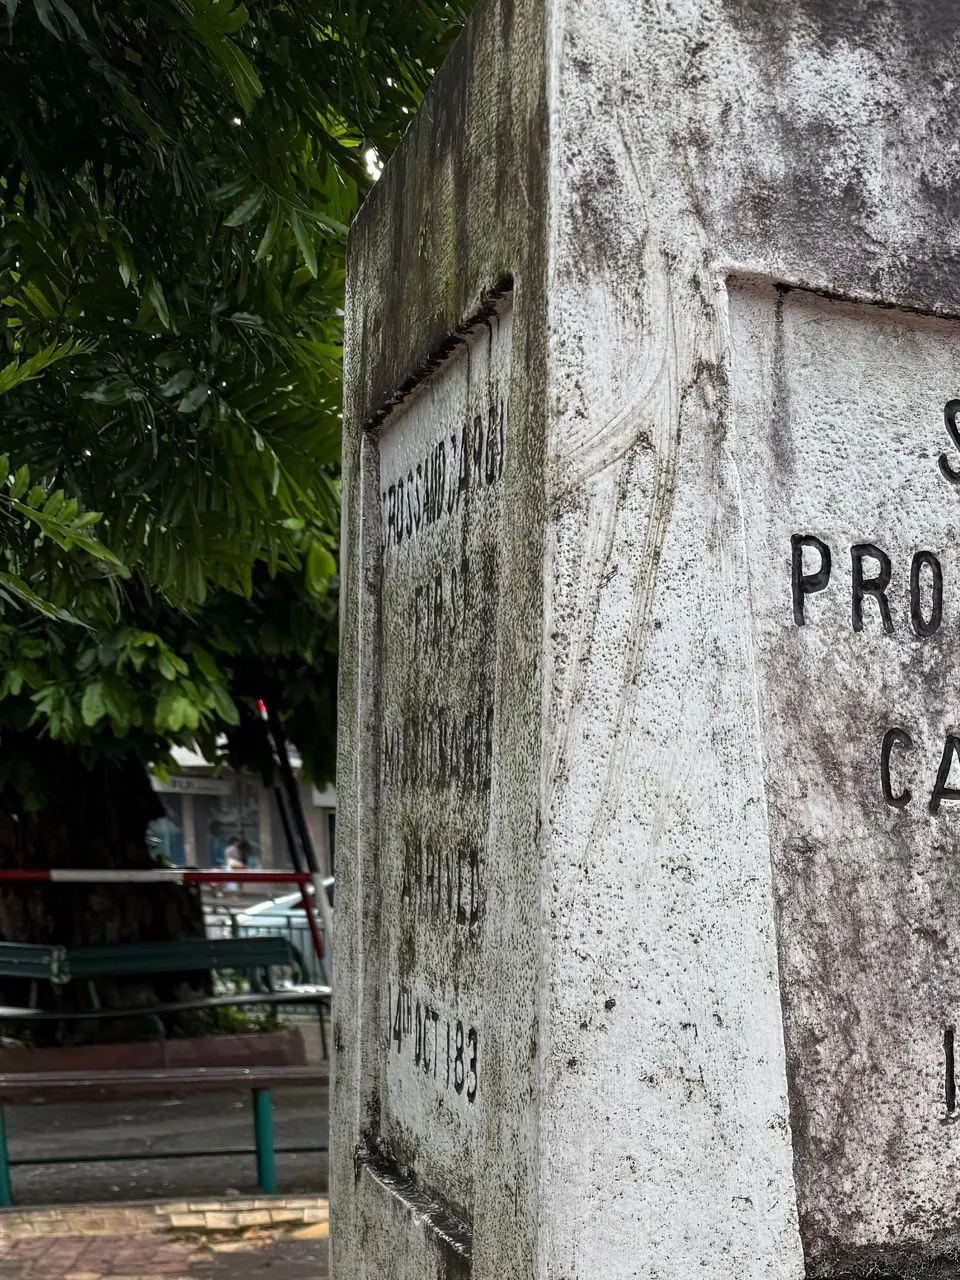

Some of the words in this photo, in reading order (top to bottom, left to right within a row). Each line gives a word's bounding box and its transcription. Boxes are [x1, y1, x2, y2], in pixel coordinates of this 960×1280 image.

[411, 556, 470, 658] FIRST
[382, 694, 493, 788] MISSIONARIE
[399, 840, 479, 925] ARRIVED
[412, 997, 439, 1081] OCT
[441, 1019, 478, 1105] 183
